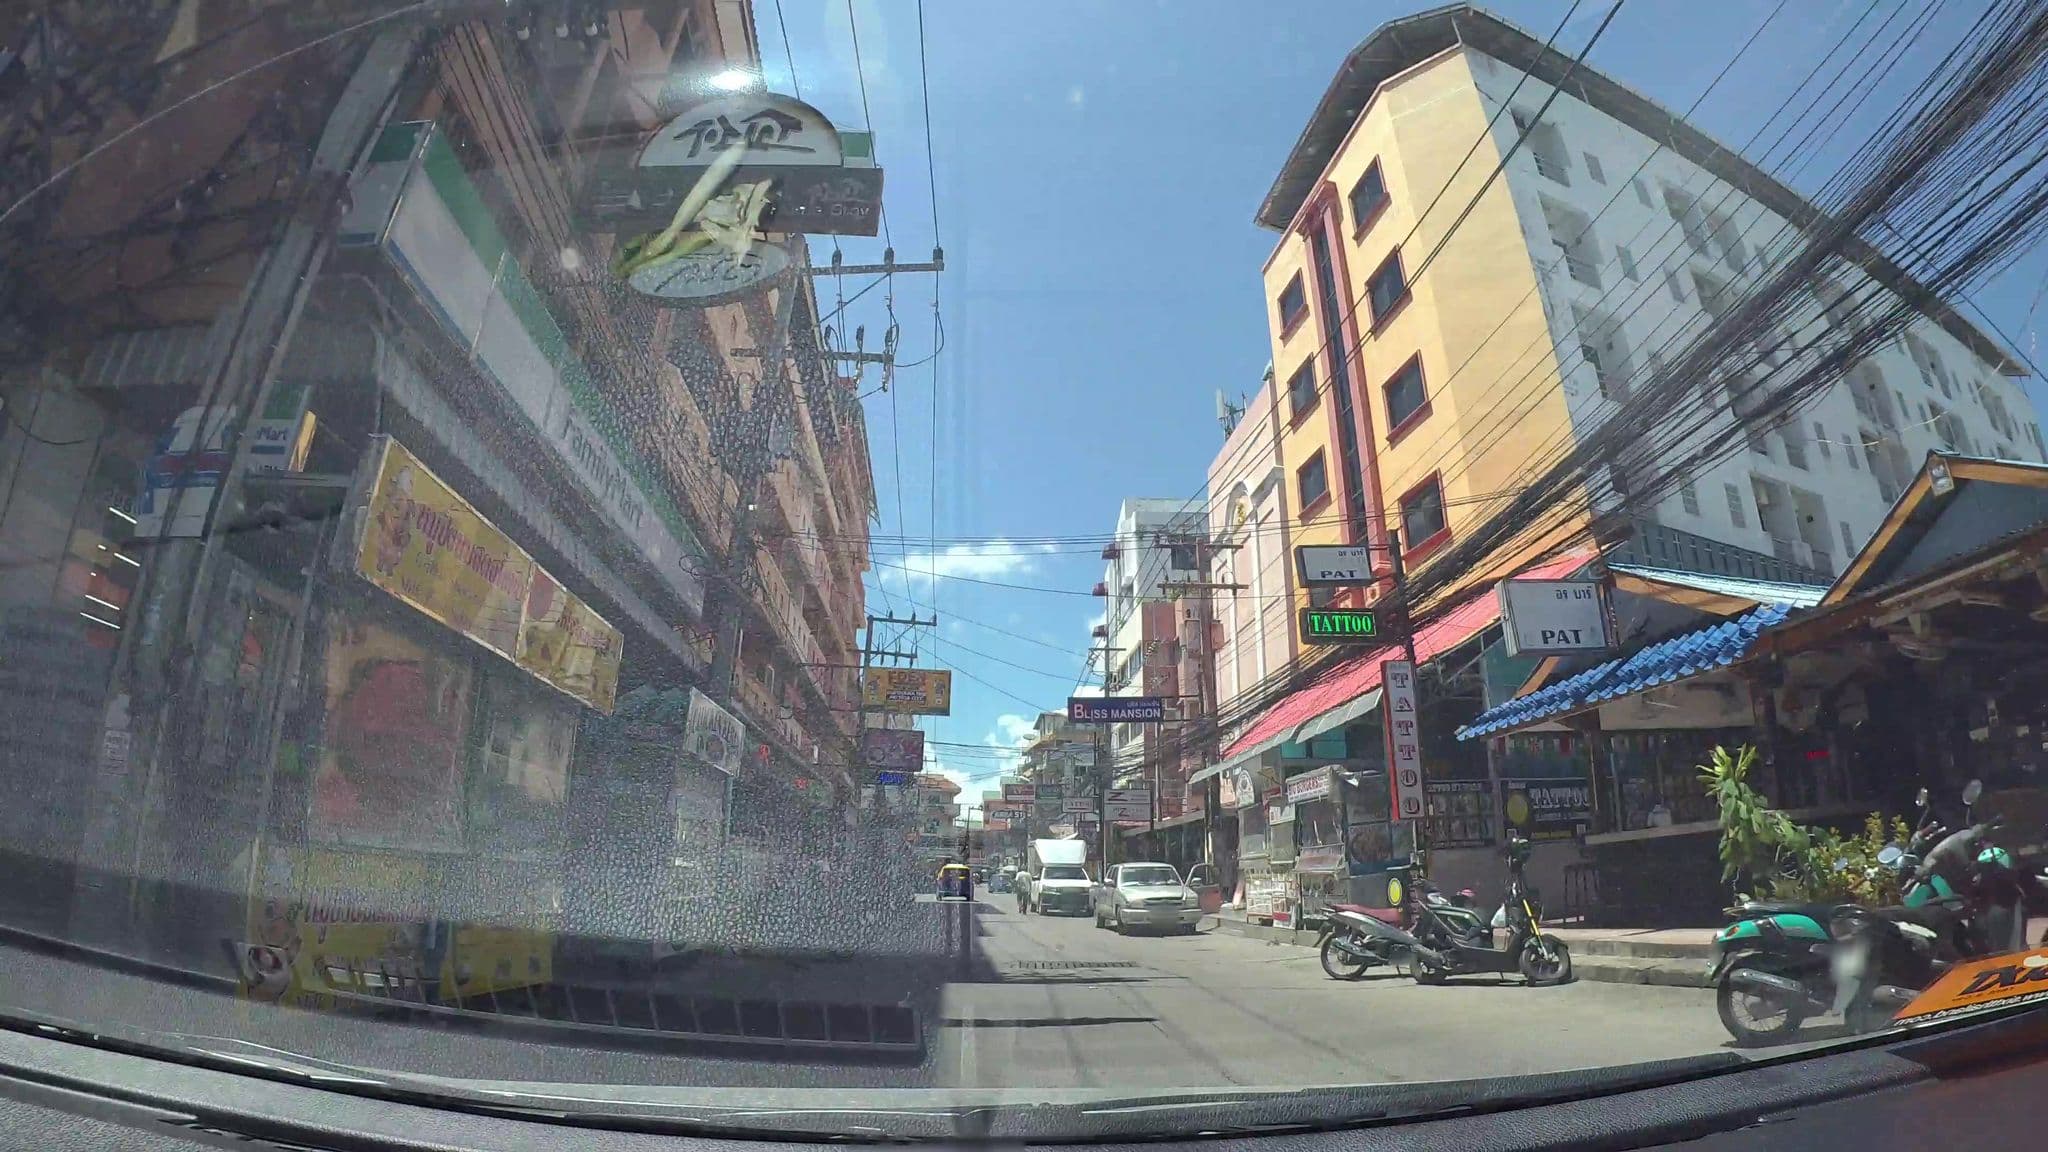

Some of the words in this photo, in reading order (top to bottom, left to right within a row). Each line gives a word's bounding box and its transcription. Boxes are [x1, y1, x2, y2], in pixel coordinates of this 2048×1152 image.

[1320, 569, 1358, 578] PAT
[1311, 615, 1372, 632] TATTOO
[1541, 629, 1582, 645] PAT
[1111, 708, 1161, 719] MANSION
[1391, 672, 1420, 815] TATTOO
